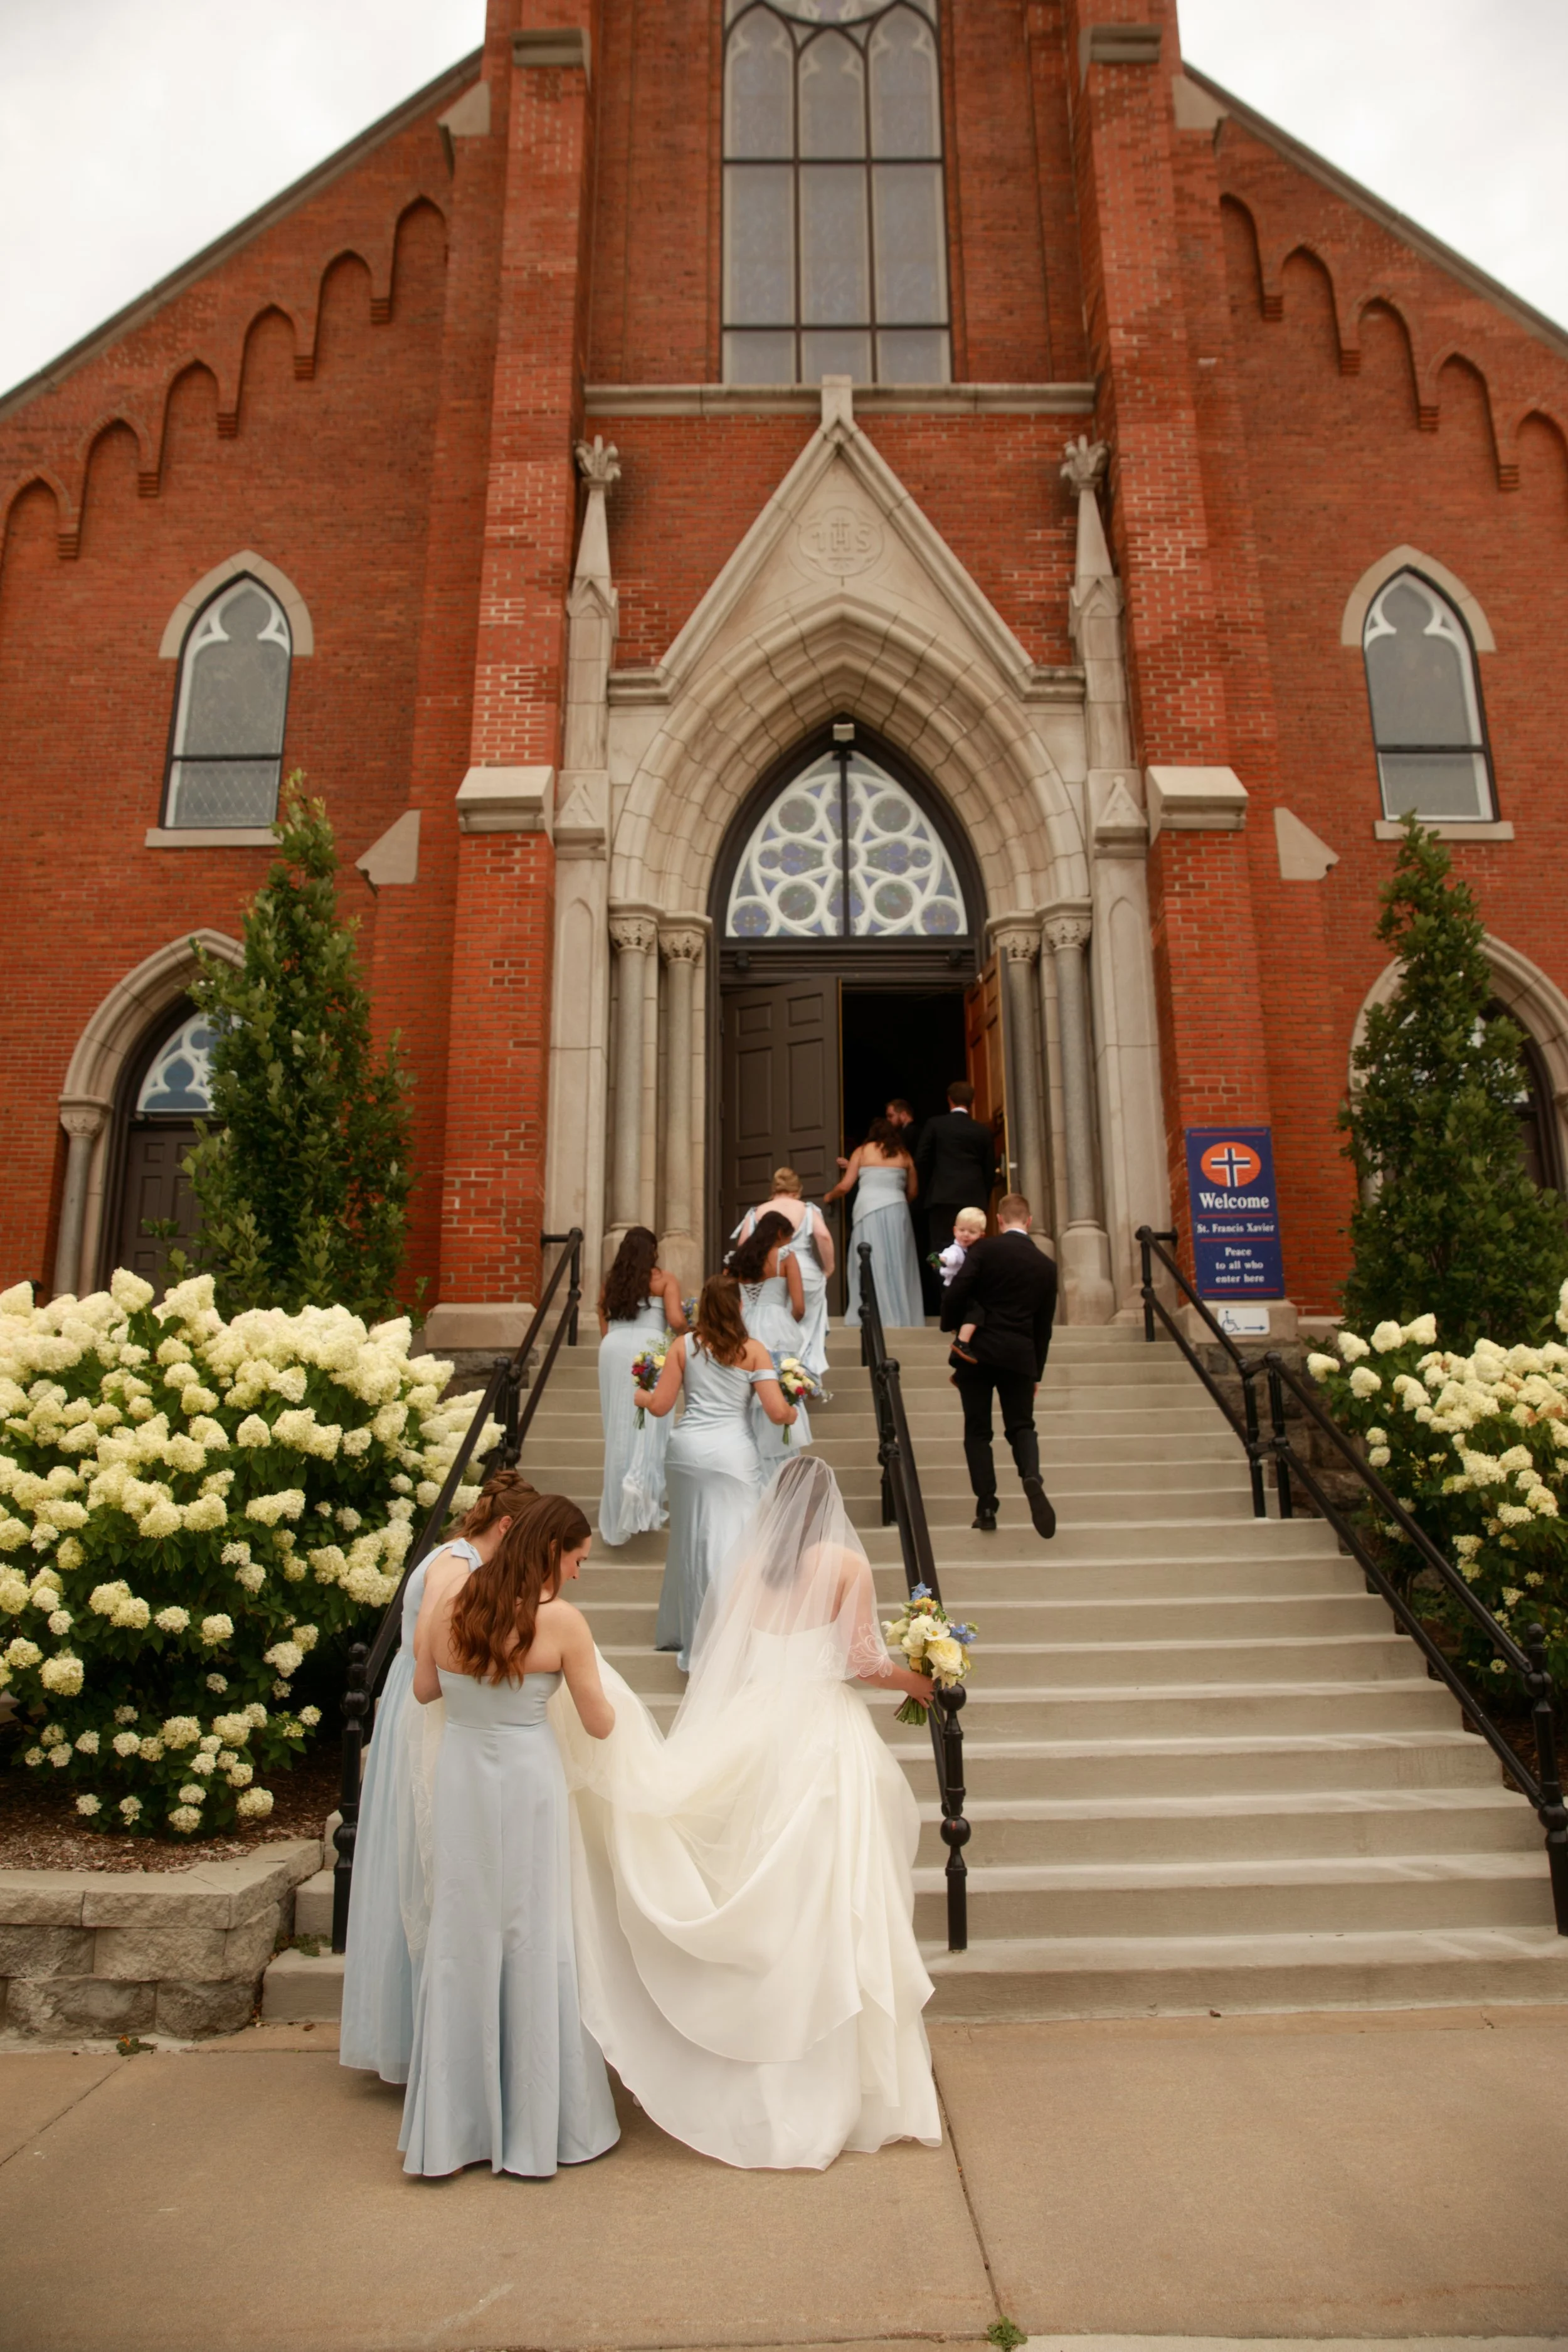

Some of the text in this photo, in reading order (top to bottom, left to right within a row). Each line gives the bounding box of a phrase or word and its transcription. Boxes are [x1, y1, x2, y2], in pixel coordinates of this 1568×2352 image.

[1199, 1192, 1269, 1209] Welcome
[1197, 1223, 1274, 1233] St. Francis Xavier
[1225, 1247, 1252, 1256] Peace
[1216, 1260, 1263, 1270] to all who
[1216, 1273, 1264, 1283] enter here
